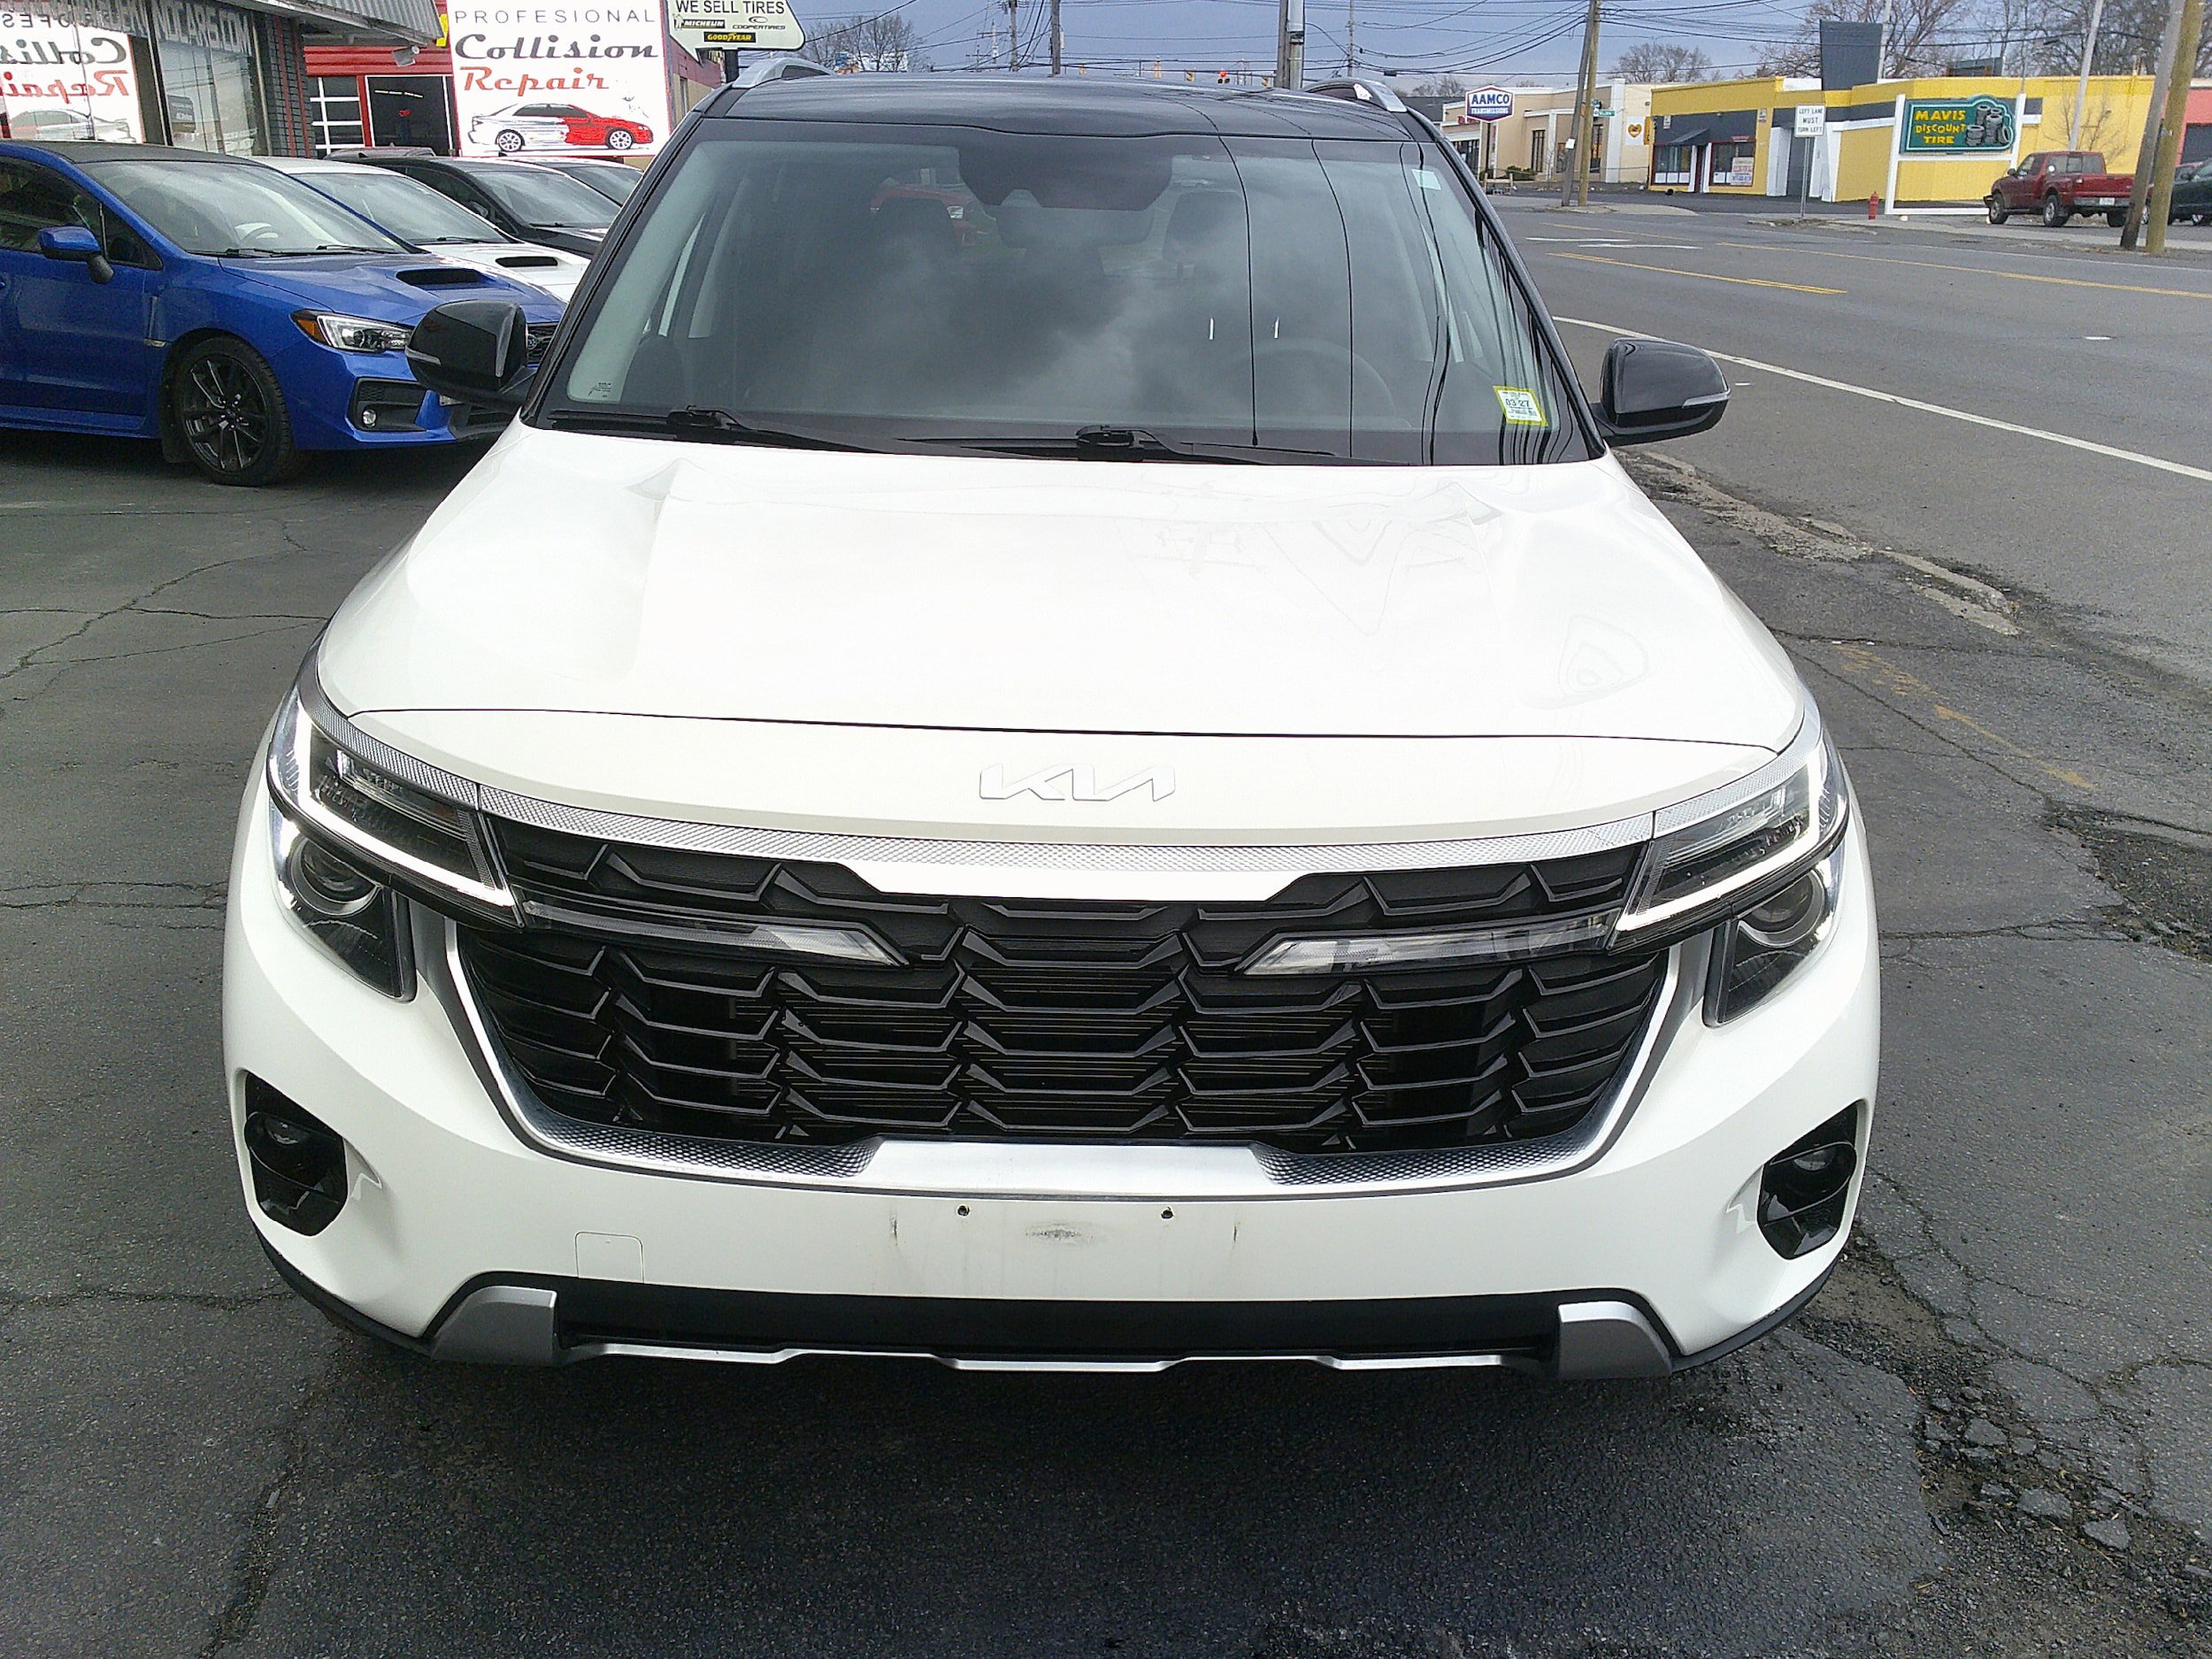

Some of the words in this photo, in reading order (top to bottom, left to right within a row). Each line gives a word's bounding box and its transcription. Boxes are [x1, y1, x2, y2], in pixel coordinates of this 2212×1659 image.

[676, 0, 700, 12] WE
[703, 0, 739, 13] SELL
[743, 0, 785, 14] TIRES
[454, 9, 656, 24] PROFESIONAL
[707, 33, 752, 42] GOODYEAR
[454, 33, 658, 59] Collision
[459, 65, 610, 97] Repair
[1471, 94, 1509, 104] AAMCO
[1915, 110, 1966, 121] MAVIS
[1915, 123, 1966, 134] DISCOUNT
[1923, 135, 1955, 144] TIRE
